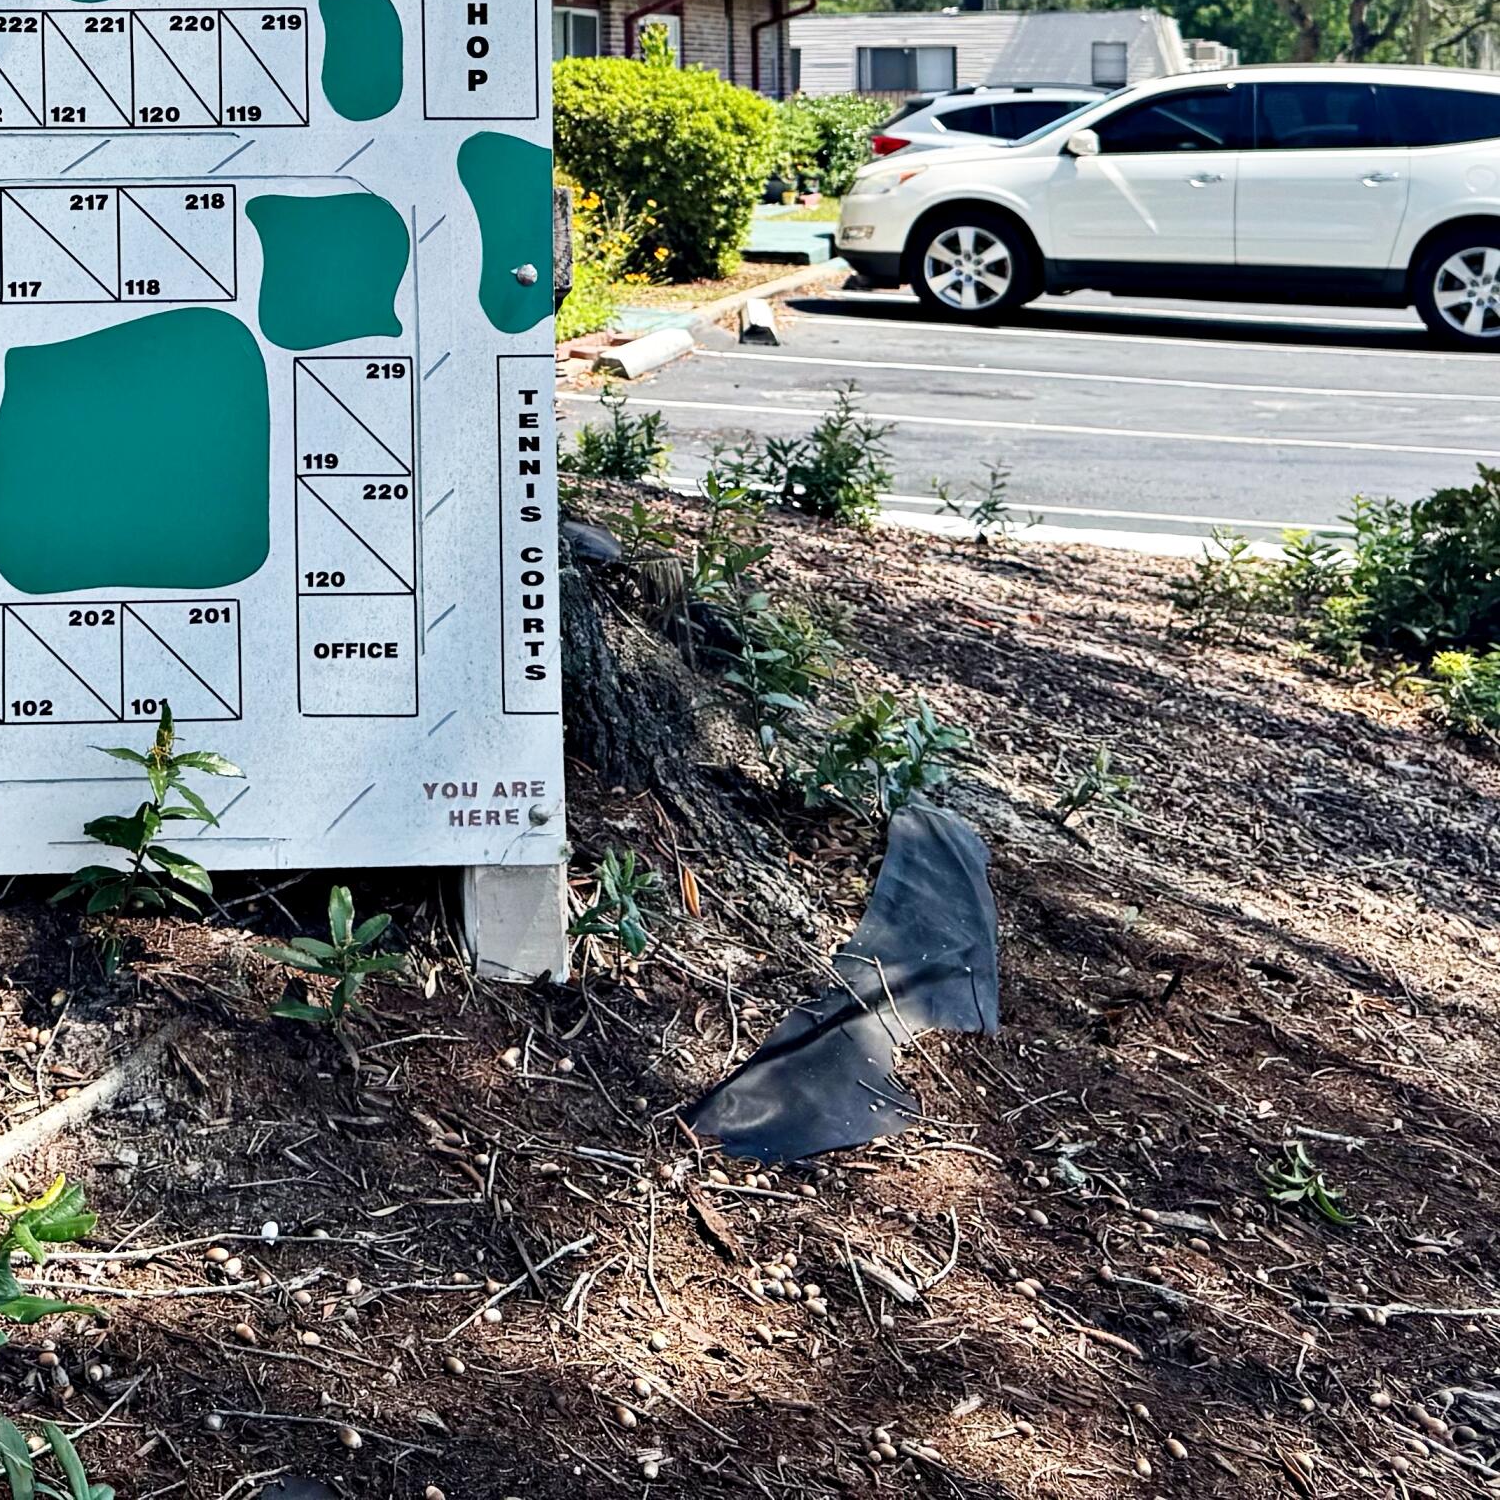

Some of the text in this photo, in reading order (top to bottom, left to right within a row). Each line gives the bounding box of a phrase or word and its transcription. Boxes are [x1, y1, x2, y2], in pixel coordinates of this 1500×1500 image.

[84, 16, 125, 33] 221
[169, 15, 215, 32] 220
[261, 14, 302, 31] 219
[50, 106, 86, 123] 121
[138, 106, 181, 123] 120
[226, 105, 262, 122] 119
[69, 194, 109, 211] 217
[184, 192, 226, 211] 218
[7, 281, 42, 298] 117
[124, 279, 161, 296] 118
[366, 362, 406, 380] 219
[302, 453, 339, 470] 119
[362, 483, 409, 500] 220
[518, 389, 547, 681] TENNIS COURTS
[304, 571, 346, 588] 120
[68, 609, 116, 627] 202
[188, 607, 231, 625] 201
[313, 642, 399, 660] OFFICE
[11, 699, 53, 717] 102
[130, 697, 168, 716] 10
[422, 780, 546, 800] YOU ARE
[448, 808, 520, 828] HERE
